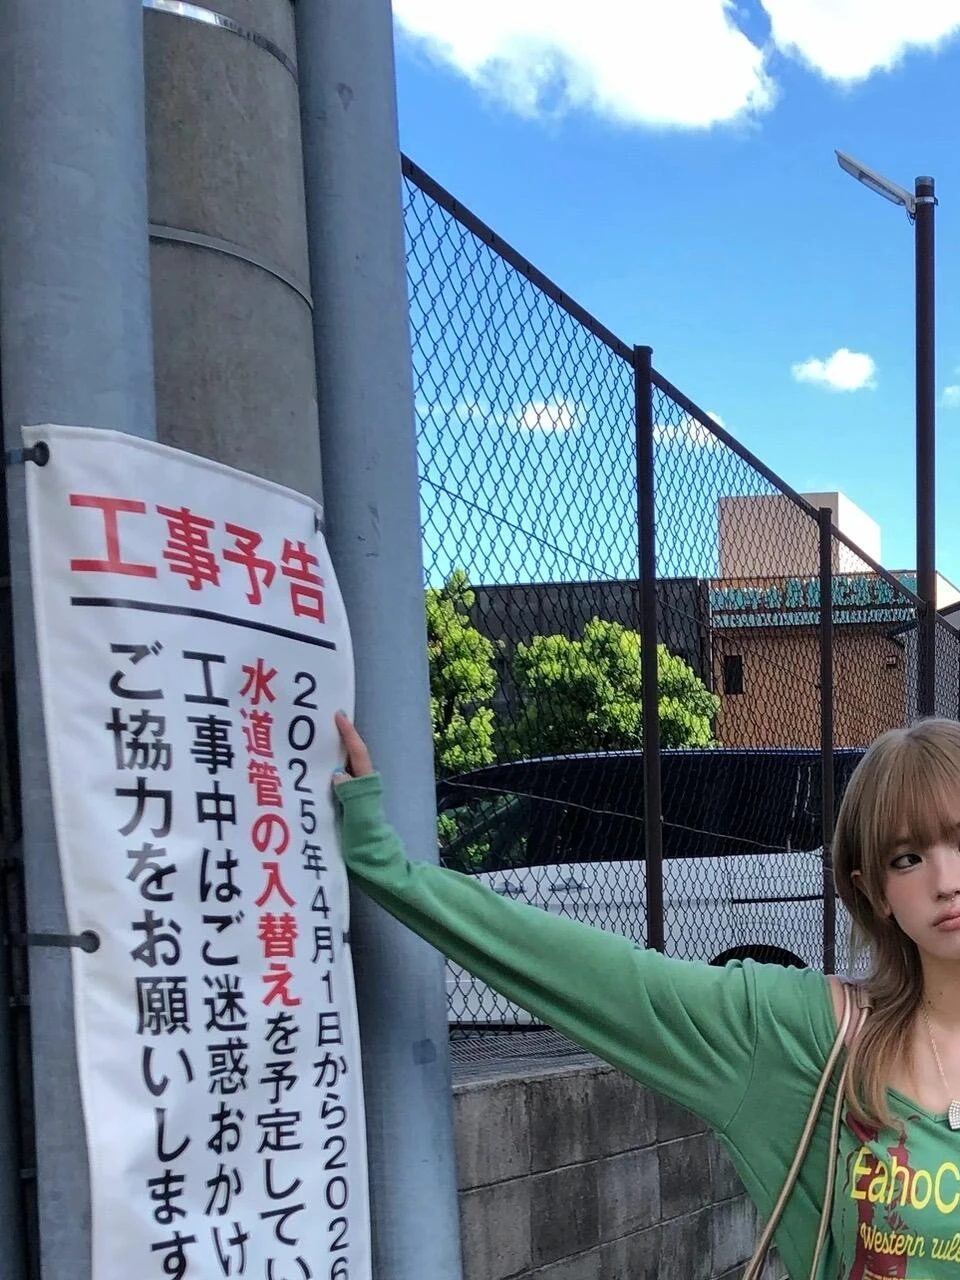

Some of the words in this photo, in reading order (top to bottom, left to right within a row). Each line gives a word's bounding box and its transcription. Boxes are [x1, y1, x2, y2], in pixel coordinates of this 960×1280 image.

[69, 493, 326, 625] 工事予告
[860, 1222, 925, 1257] Western
